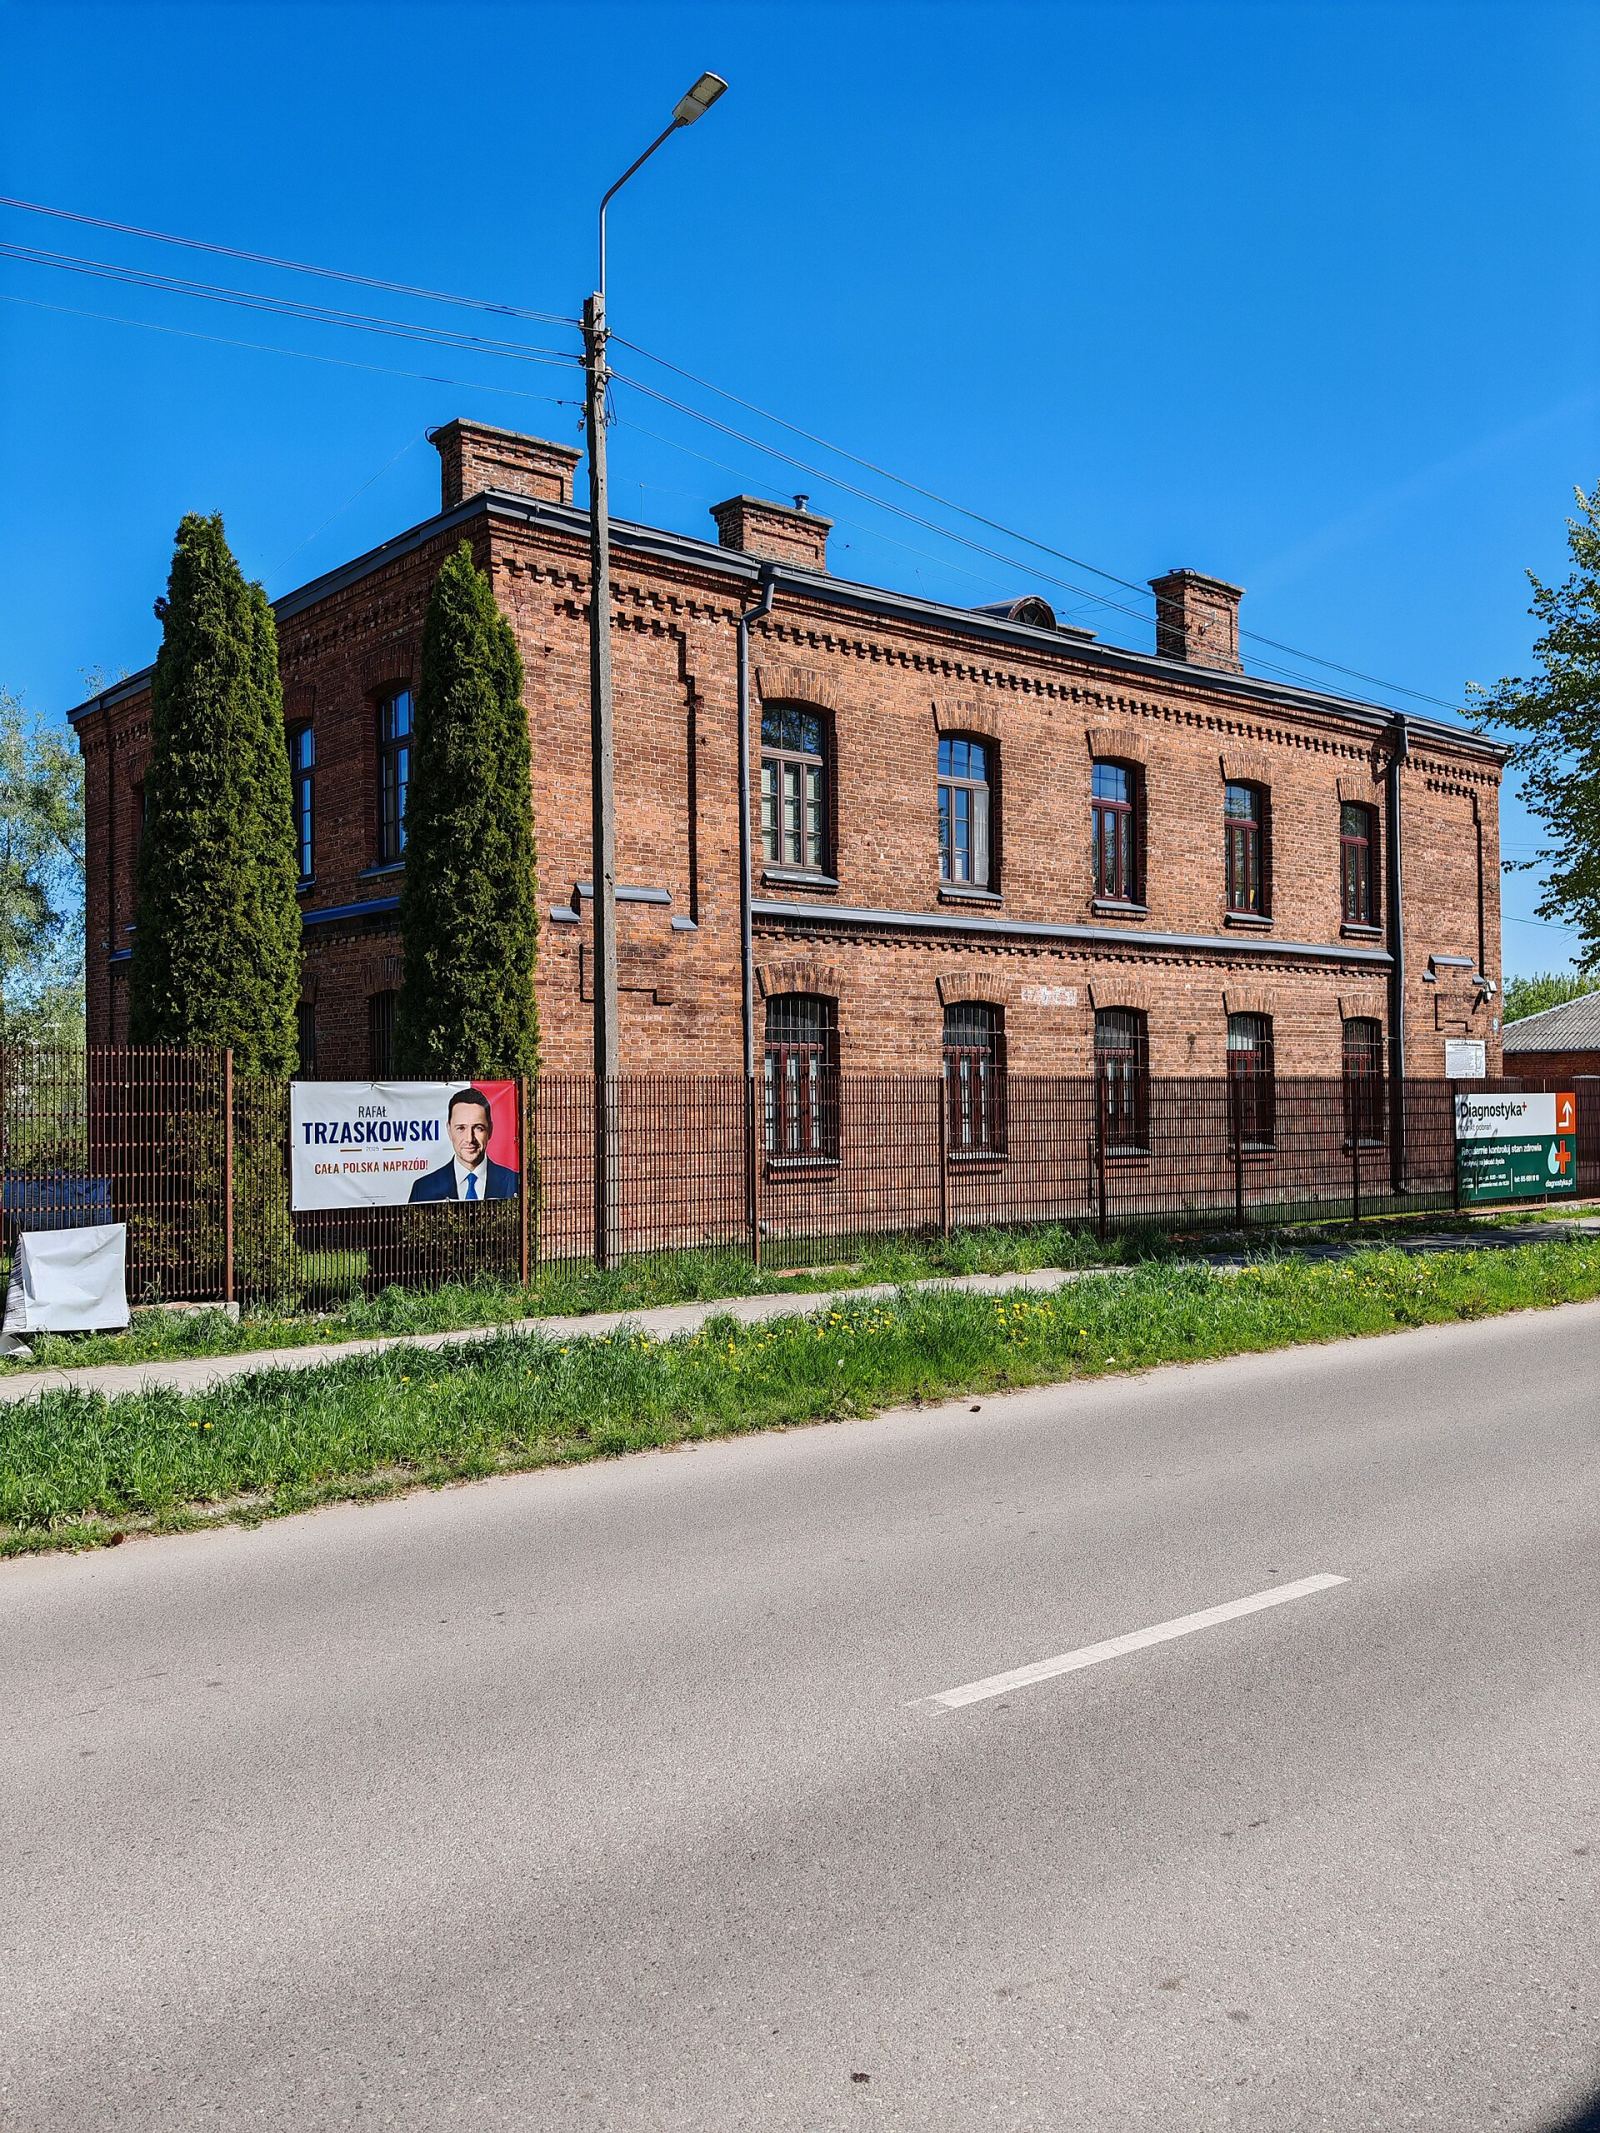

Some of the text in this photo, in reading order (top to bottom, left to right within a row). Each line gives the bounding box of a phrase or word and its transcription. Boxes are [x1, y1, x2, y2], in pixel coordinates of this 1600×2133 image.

[358, 1105, 388, 1118] RAFAŁ
[302, 1120, 440, 1144] TRZASKOWSKI
[1488, 1142, 1511, 1156] kontroluj
[1511, 1143, 1523, 1153] stan
[1523, 1142, 1542, 1153] zdrowia
[314, 1157, 429, 1175] CAŁA POLSKA NAPRZÓD!
